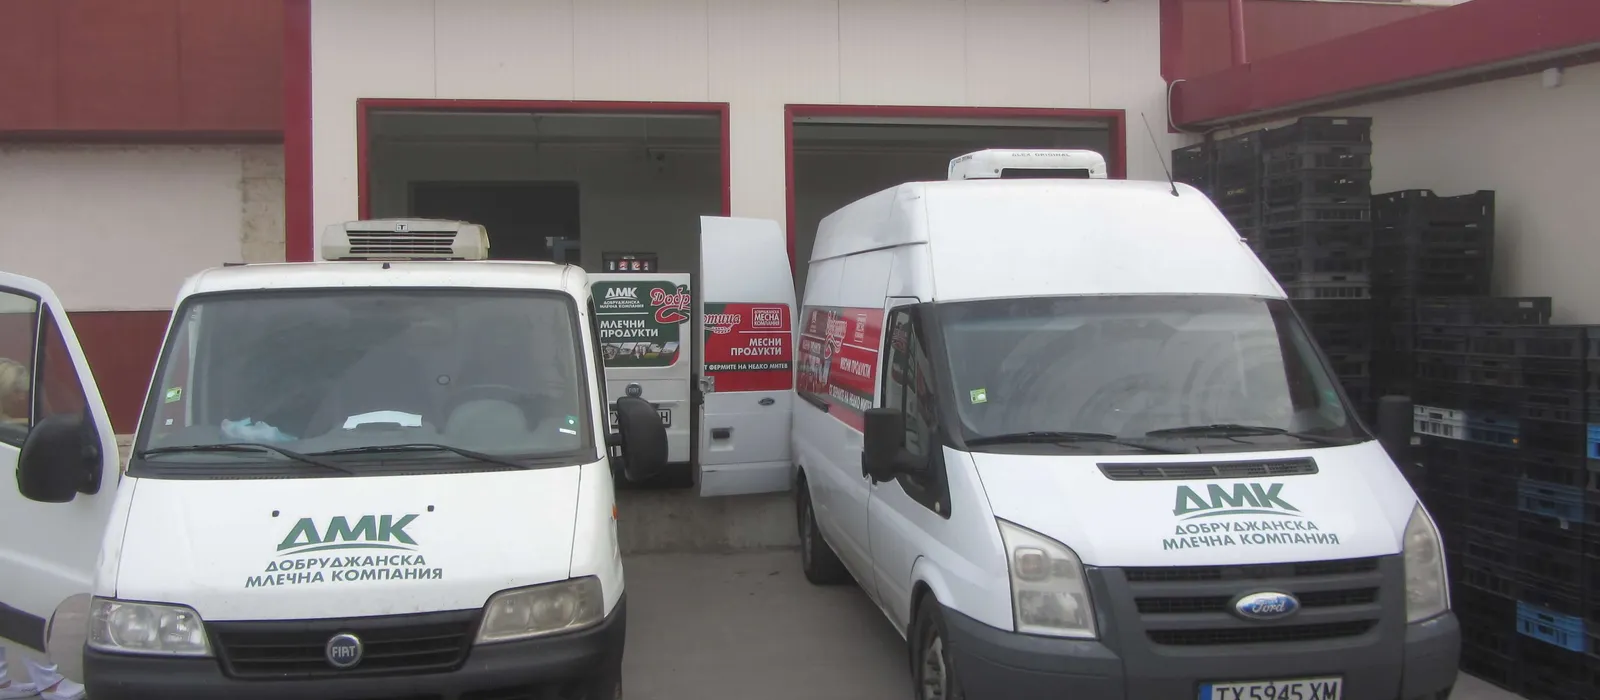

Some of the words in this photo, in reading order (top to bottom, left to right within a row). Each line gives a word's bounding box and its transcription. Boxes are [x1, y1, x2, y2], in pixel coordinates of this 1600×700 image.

[605, 287, 638, 298] ДМК
[754, 313, 780, 321] МЕСНА
[600, 319, 645, 329] МЛЕЧНИ
[600, 328, 659, 338] ПРОДУКТИ
[749, 338, 782, 347] МЕСНИ
[730, 347, 782, 356] ПРОДУКТИ
[1172, 483, 1302, 516] ДМК
[277, 514, 420, 551] ДМК
[1175, 521, 1319, 535] ДОБРУДЖАНСКА
[1162, 534, 1236, 550] МЛЕЧНА
[1240, 533, 1340, 545] КОМПАНИЯ
[265, 555, 426, 572] ДОБРУДЖАНСКА
[244, 571, 325, 588] МЛЕЧНА
[331, 567, 443, 582] КОМПАНИЯ
[1251, 601, 1286, 613] Ford
[332, 645, 356, 658] FIAT
[1250, 684, 1303, 700] 5945
[1310, 682, 1338, 700] XM
